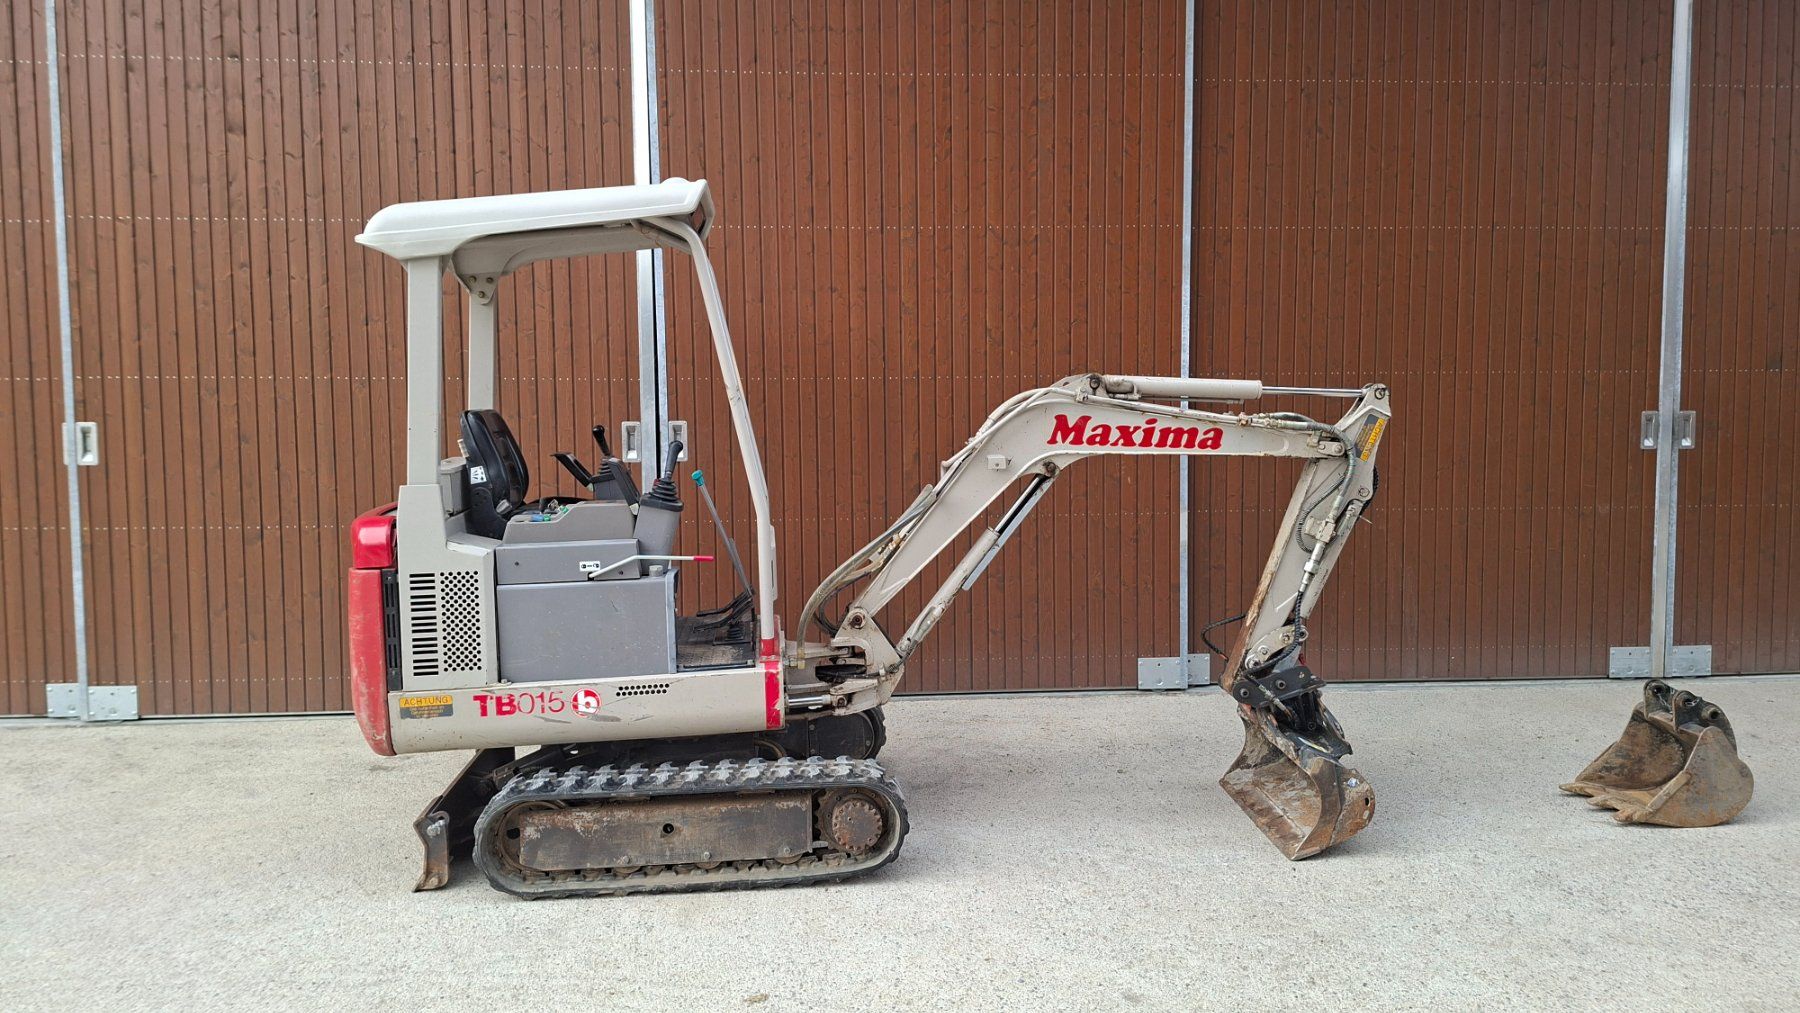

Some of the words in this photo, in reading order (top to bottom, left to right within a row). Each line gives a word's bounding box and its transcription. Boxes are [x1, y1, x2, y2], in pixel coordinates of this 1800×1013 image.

[1047, 413, 1223, 450] Maxima
[404, 696, 448, 706] ACHTUNG
[473, 690, 566, 717] TB015
